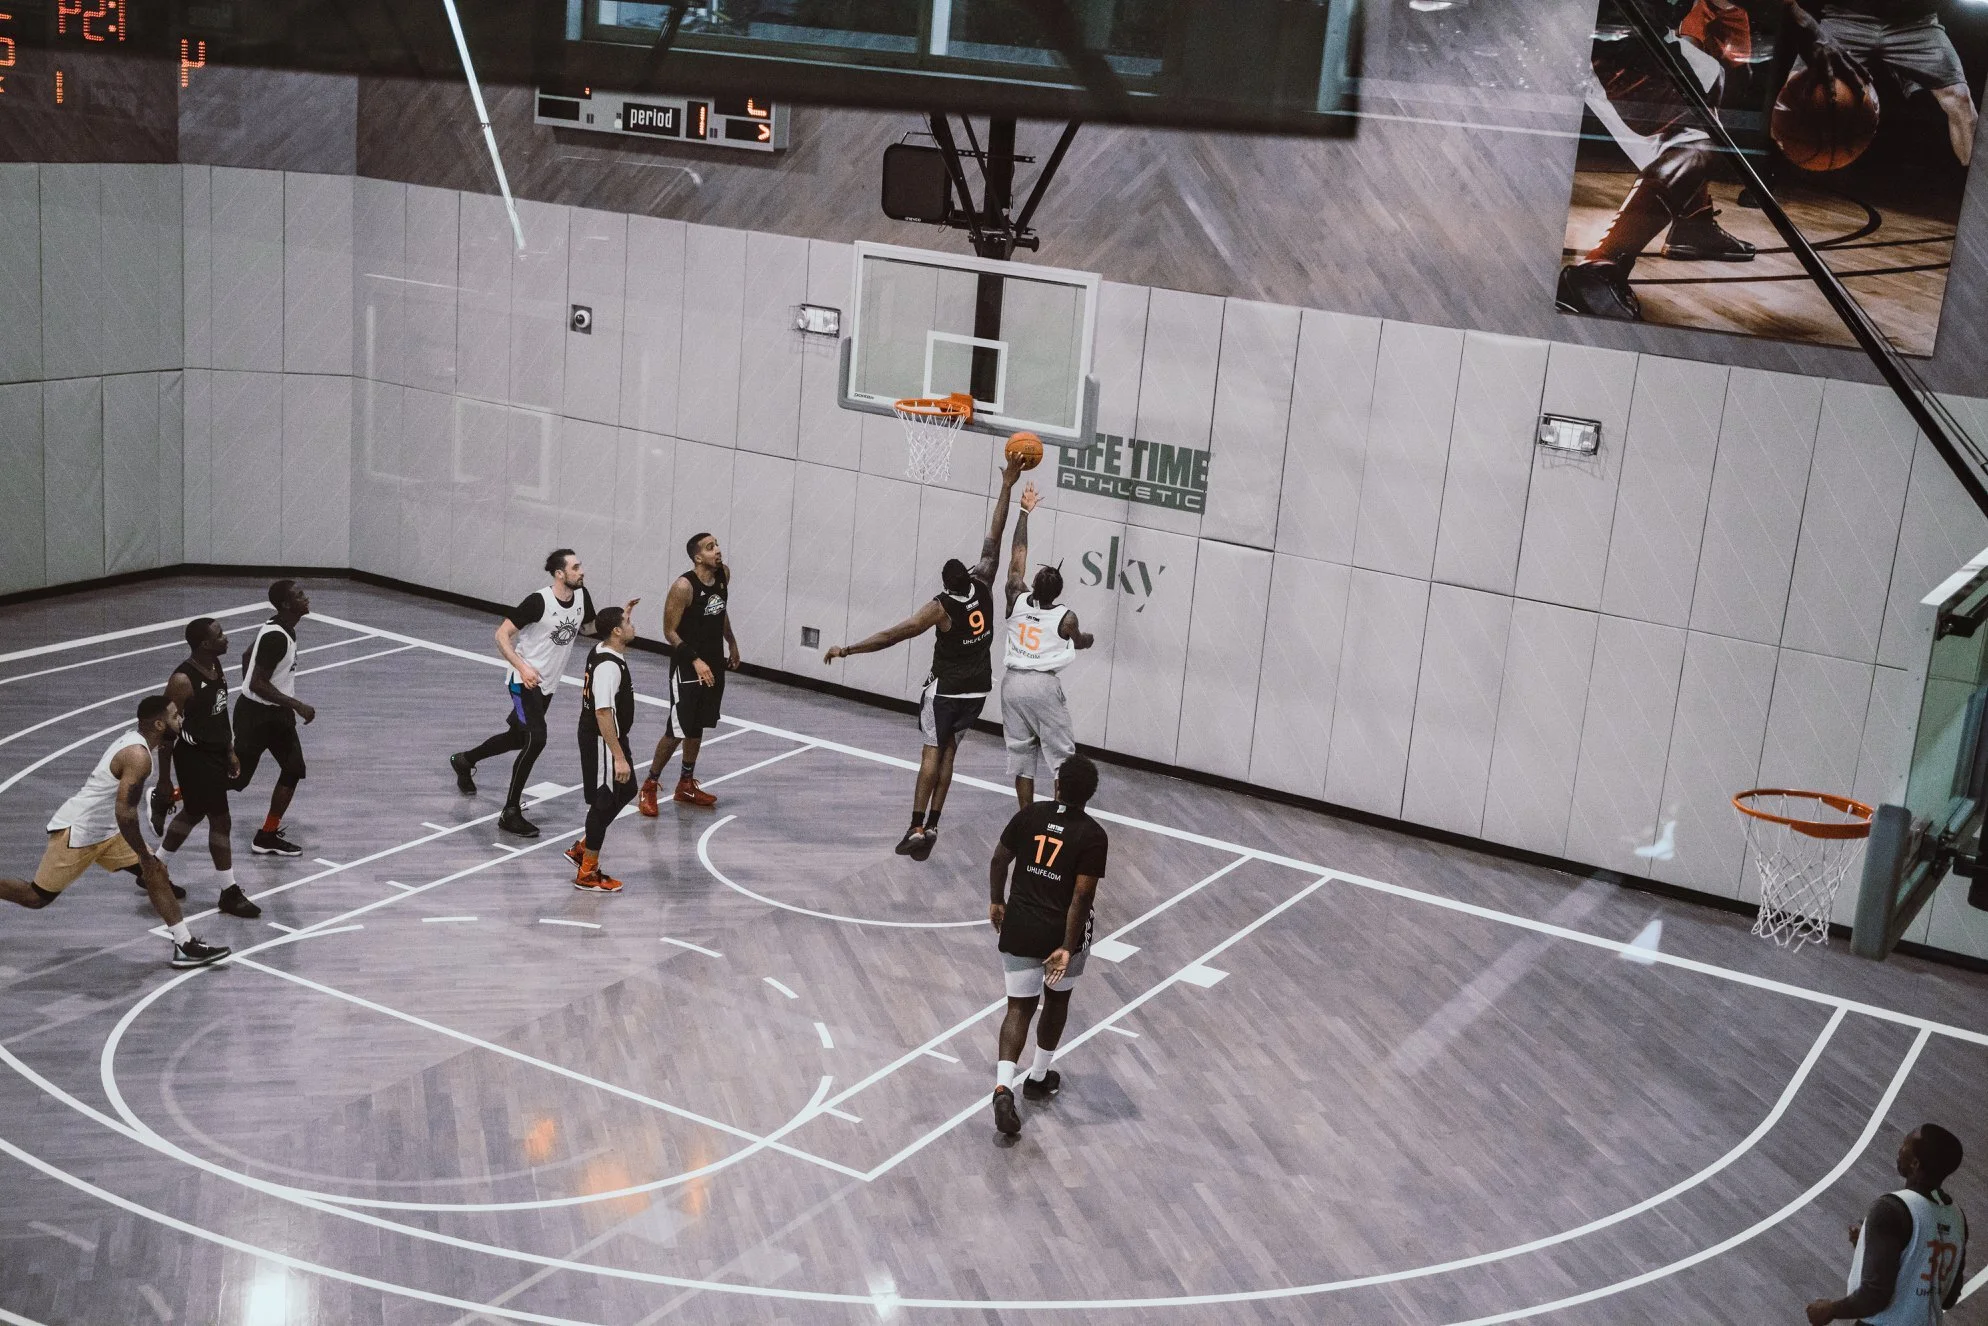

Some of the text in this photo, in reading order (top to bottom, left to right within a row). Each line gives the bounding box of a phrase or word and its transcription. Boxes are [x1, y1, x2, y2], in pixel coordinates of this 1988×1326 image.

[629, 107, 673, 129] period
[1127, 437, 1212, 490] TIME
[1061, 472, 1203, 509] ATHLETIC
[1080, 536, 1166, 613] sky
[969, 610, 985, 636] 9
[1018, 622, 1043, 651] 15
[1034, 834, 1063, 868] 17
